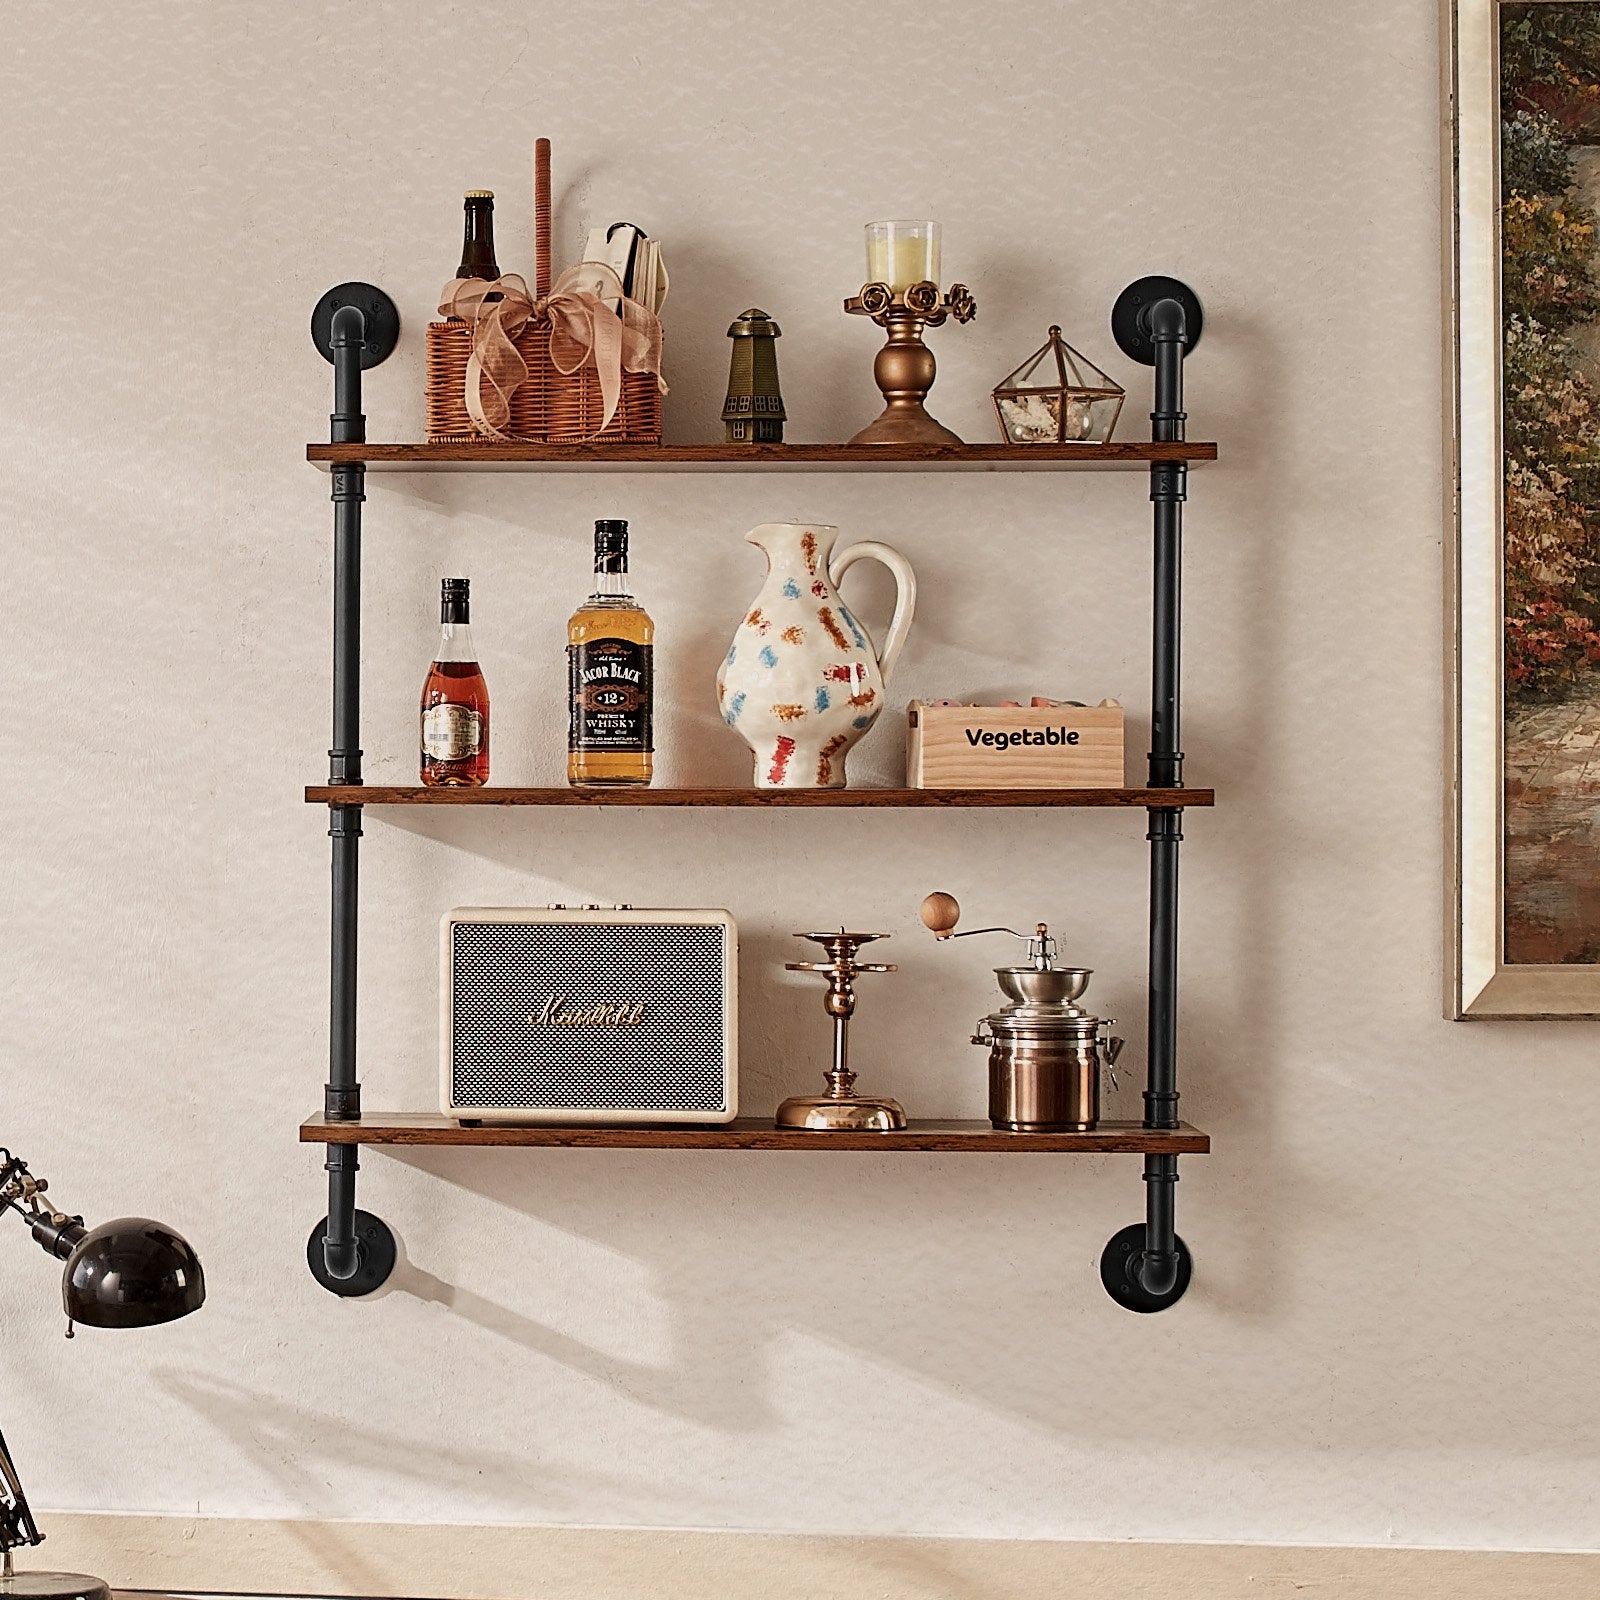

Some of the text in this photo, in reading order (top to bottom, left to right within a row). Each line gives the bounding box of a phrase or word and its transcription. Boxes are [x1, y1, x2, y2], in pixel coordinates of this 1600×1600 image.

[610, 662, 642, 683] BLACK
[603, 693, 618, 704] 12
[586, 719, 636, 728] WHISKY
[965, 726, 1080, 751] Vegetable
